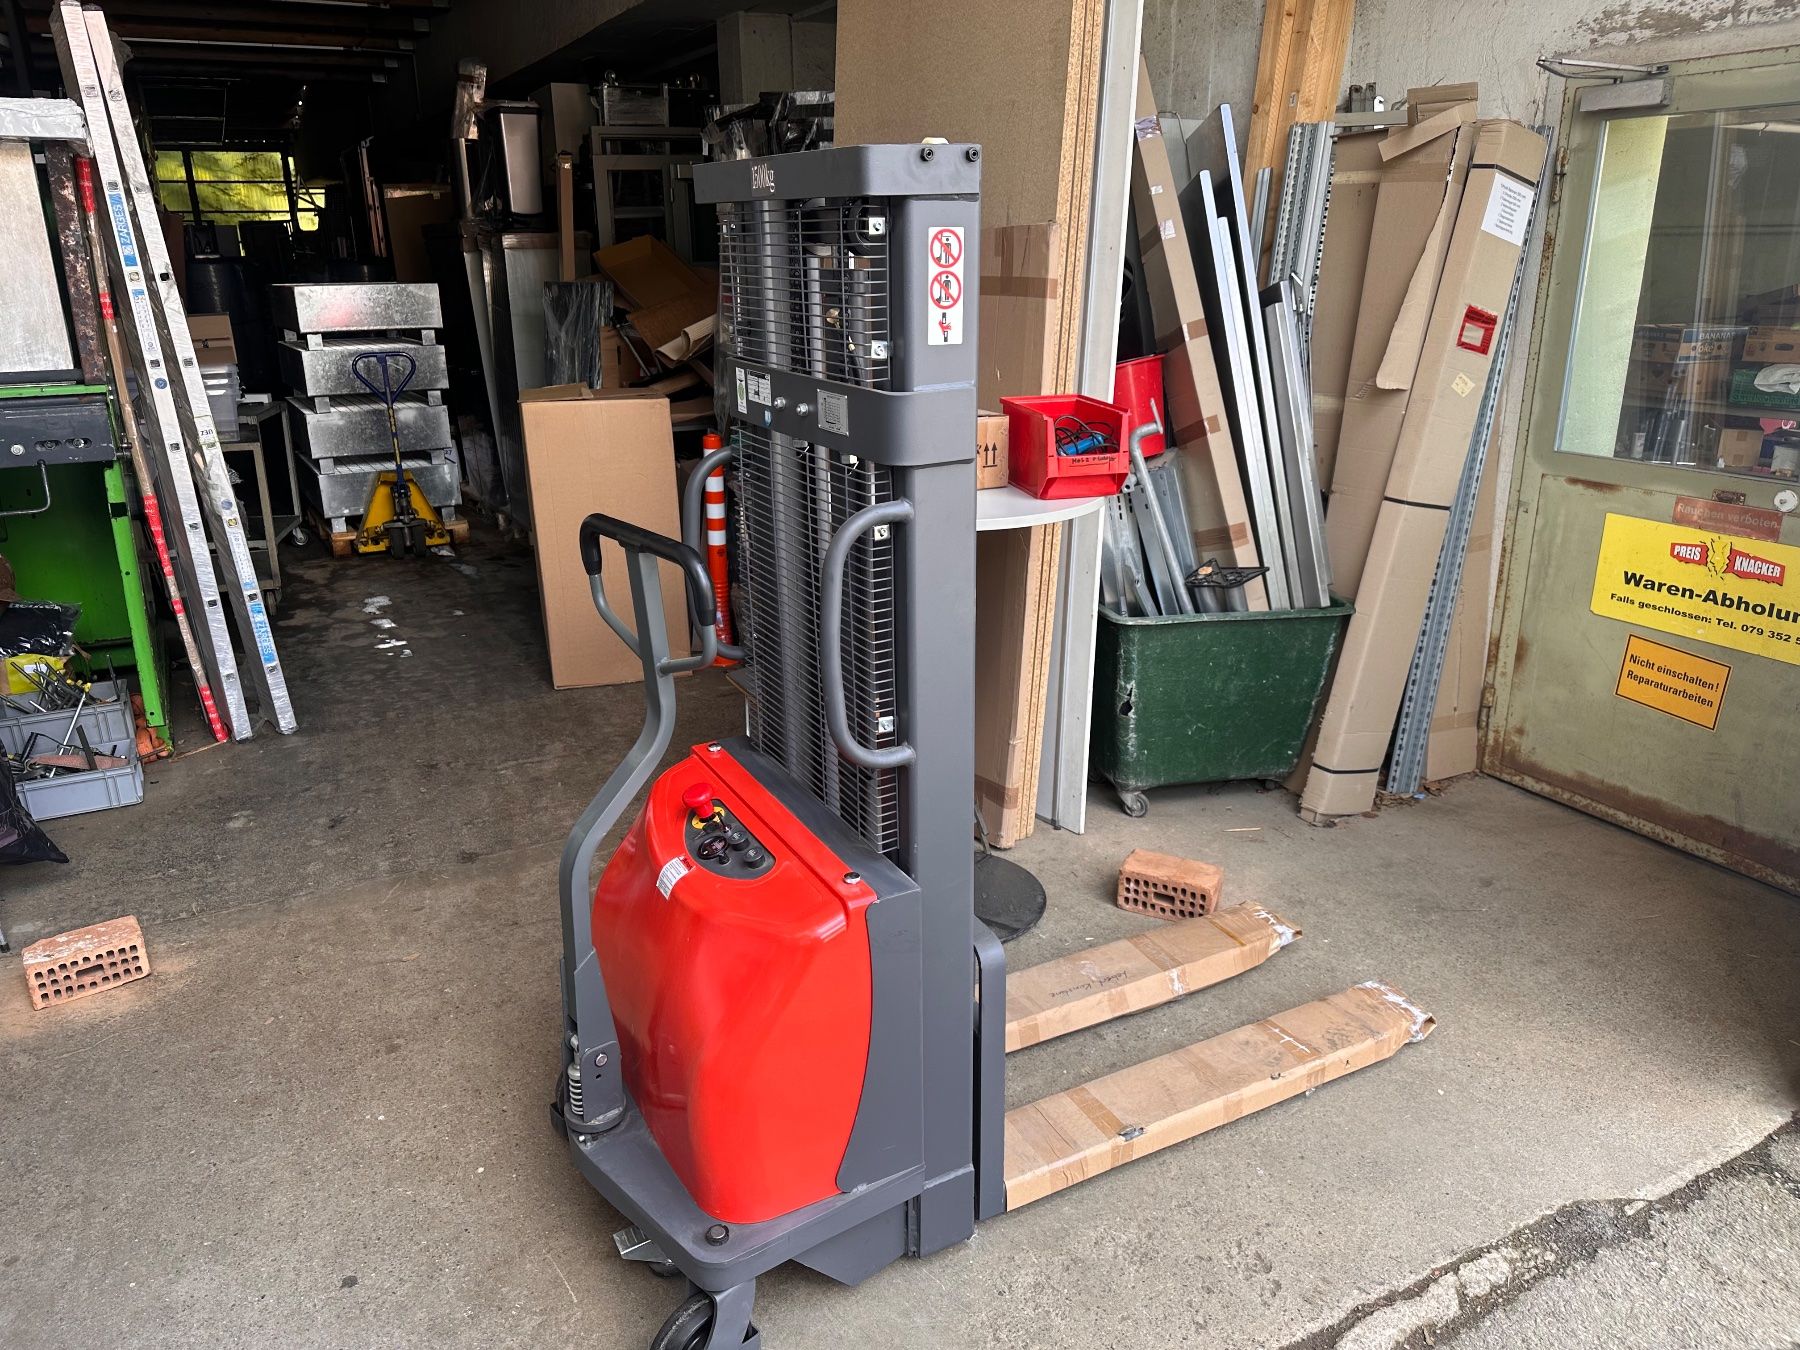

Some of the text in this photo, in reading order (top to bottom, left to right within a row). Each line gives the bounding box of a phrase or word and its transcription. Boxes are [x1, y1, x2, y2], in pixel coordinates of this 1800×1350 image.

[751, 163, 775, 193] 1500kg
[112, 205, 133, 245] ZARGES
[1677, 503, 1723, 520] Rauchen
[1673, 545, 1702, 561] PREIS
[1733, 555, 1781, 578] KNACKER
[1610, 593, 1635, 606] Falls
[1638, 600, 1712, 624] geschlossen:
[1716, 618, 1737, 630] Tel.
[1741, 624, 1764, 636] 079
[1768, 630, 1791, 643] 352
[256, 620, 273, 655] ZARGES
[1629, 653, 1655, 671] Nicht
[1626, 669, 1714, 708] Reparaturarbeiten
